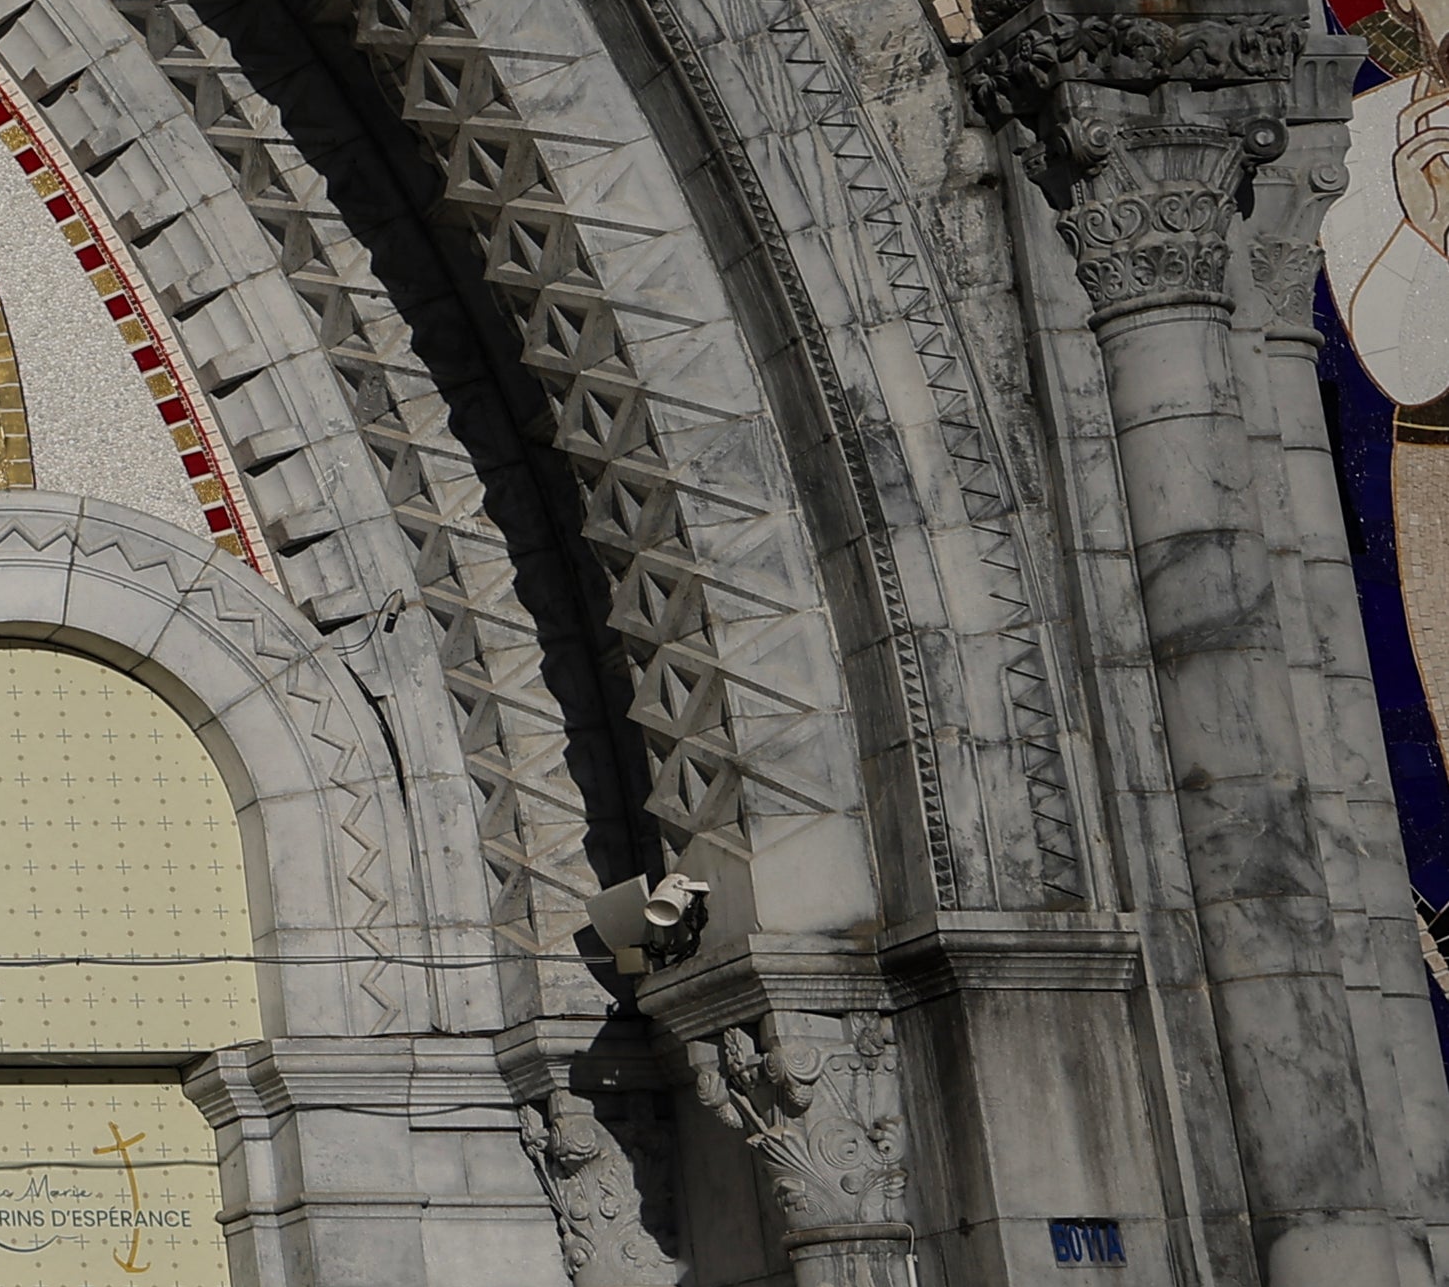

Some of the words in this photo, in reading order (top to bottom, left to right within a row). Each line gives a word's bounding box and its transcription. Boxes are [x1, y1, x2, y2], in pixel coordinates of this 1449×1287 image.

[14, 1174, 93, 1204] Marie
[52, 1205, 192, 1227] D'ESPÉRANCE
[1050, 1223, 1125, 1262] B011A
